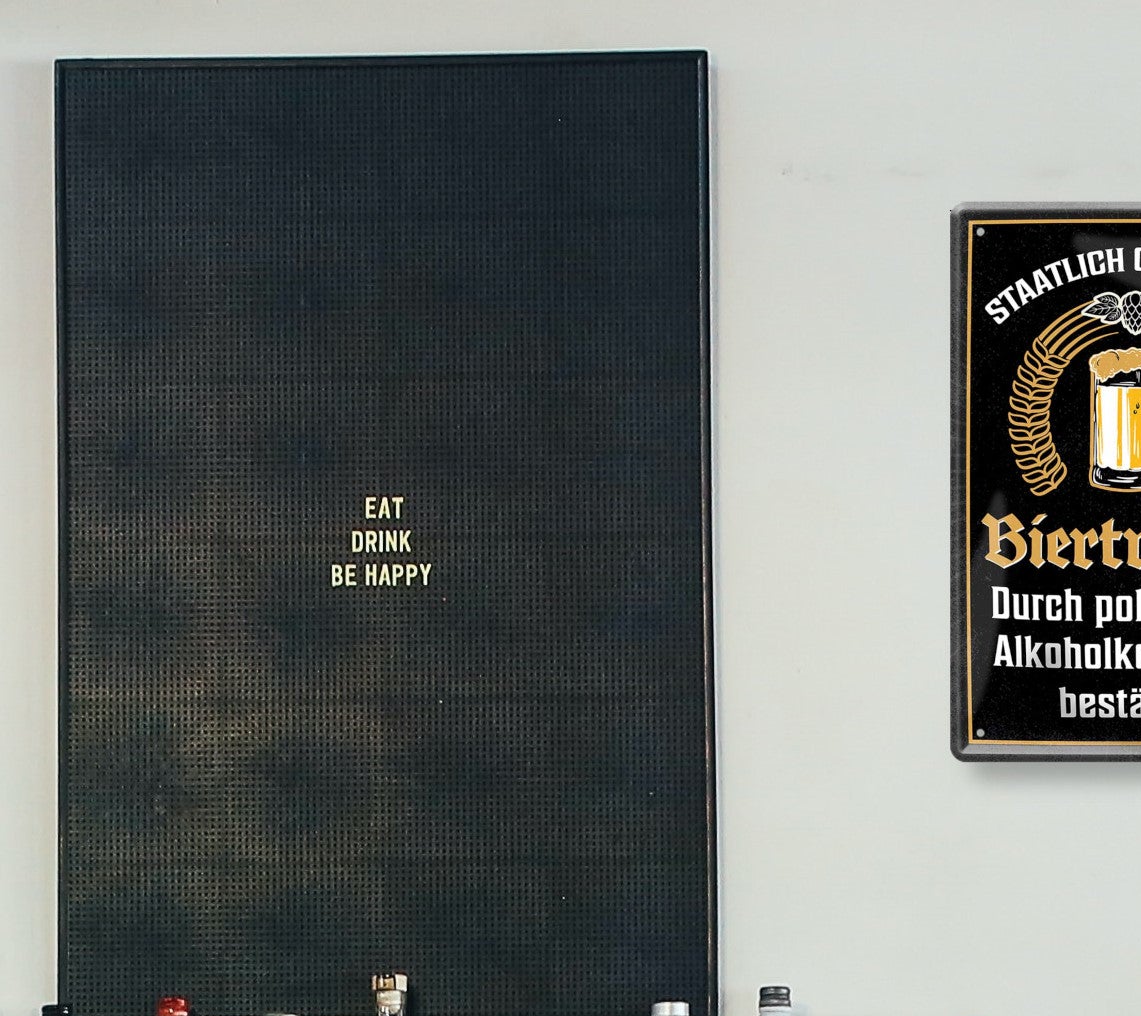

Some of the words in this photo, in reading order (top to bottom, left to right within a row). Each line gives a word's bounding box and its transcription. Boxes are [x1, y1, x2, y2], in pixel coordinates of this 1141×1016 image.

[985, 247, 1125, 325] STAATLICH
[365, 496, 404, 519] EAT
[351, 529, 412, 553] DRINK
[331, 564, 358, 587] BE
[365, 563, 432, 587] HAPPY
[991, 586, 1082, 622] Durch
